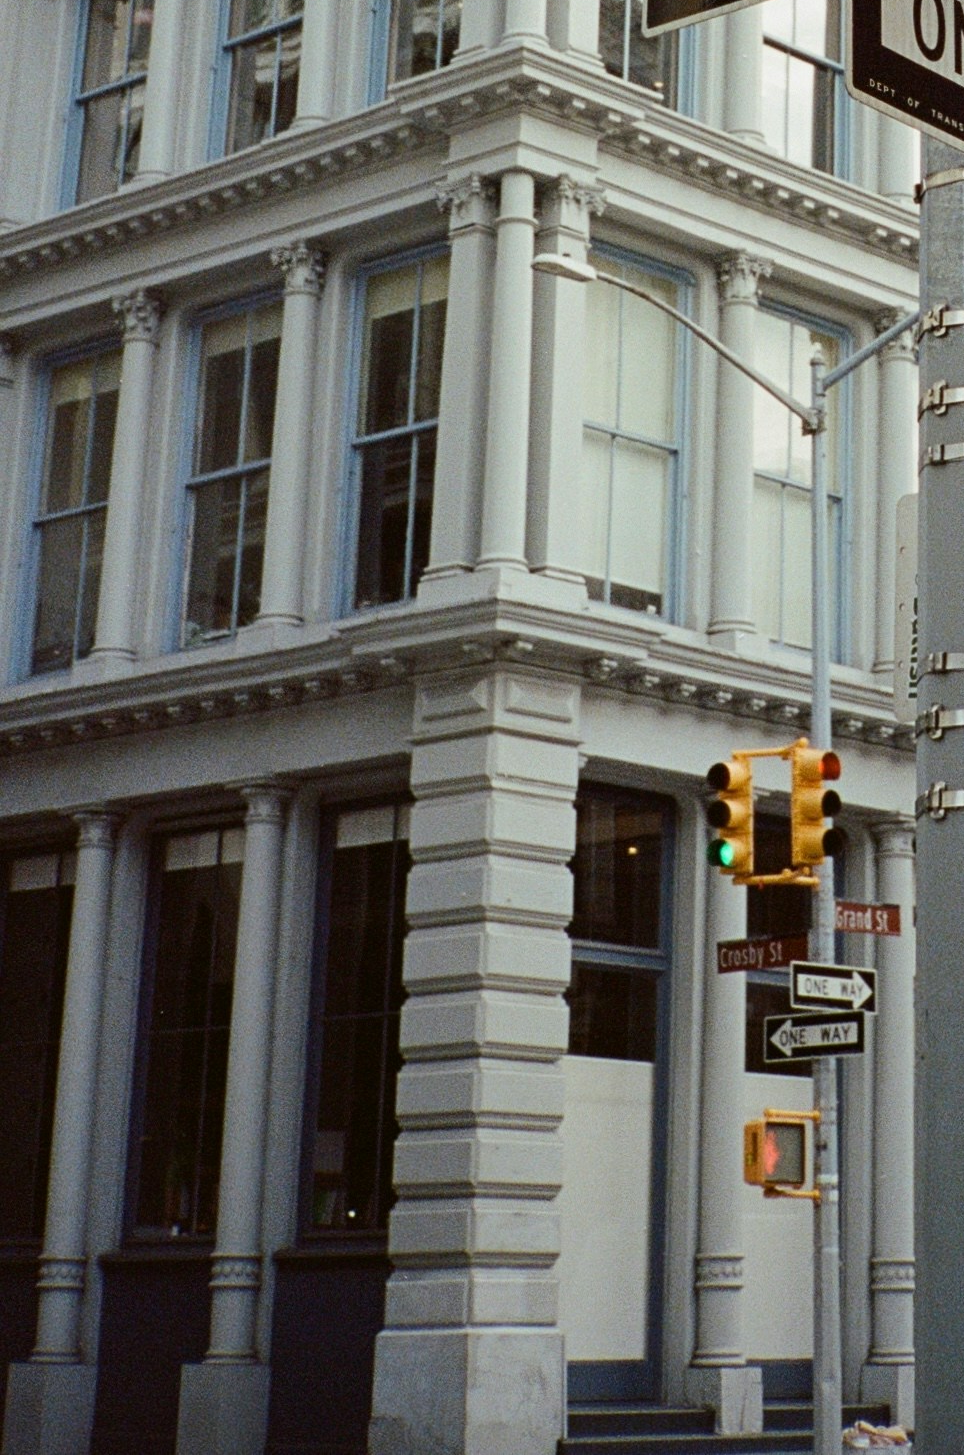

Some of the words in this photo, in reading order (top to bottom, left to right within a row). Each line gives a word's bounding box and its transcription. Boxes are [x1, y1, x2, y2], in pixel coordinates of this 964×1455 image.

[869, 78, 895, 97] DEPT
[907, 97, 920, 109] OF
[836, 907, 871, 930] Grand
[876, 910, 888, 931] St
[720, 946, 764, 968] Crosby
[769, 942, 783, 962] St
[804, 978, 829, 995] ONE
[840, 982, 864, 996] WAY
[779, 1027, 806, 1046] ONE
[820, 1025, 850, 1043] WAY
